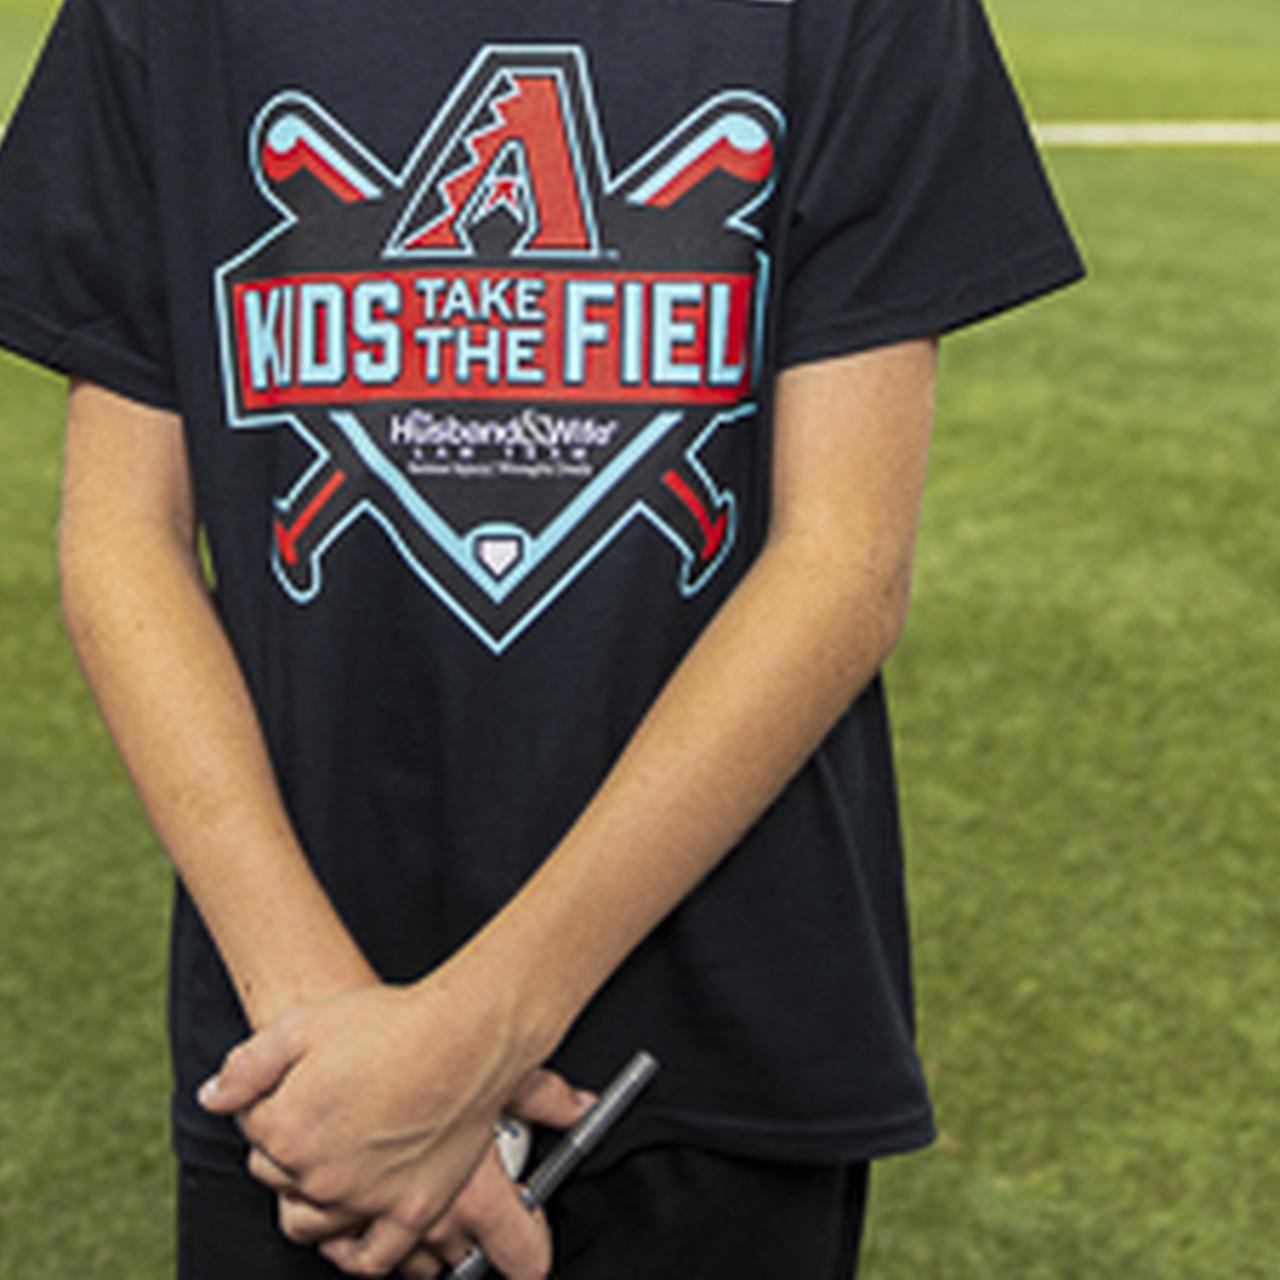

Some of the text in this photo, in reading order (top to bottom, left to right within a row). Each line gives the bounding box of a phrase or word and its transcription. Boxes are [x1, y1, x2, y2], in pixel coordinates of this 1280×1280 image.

[242, 281, 401, 390] KIDS
[415, 277, 546, 321] TAKE
[563, 280, 745, 385] FIEL
[415, 327, 546, 382] THE
